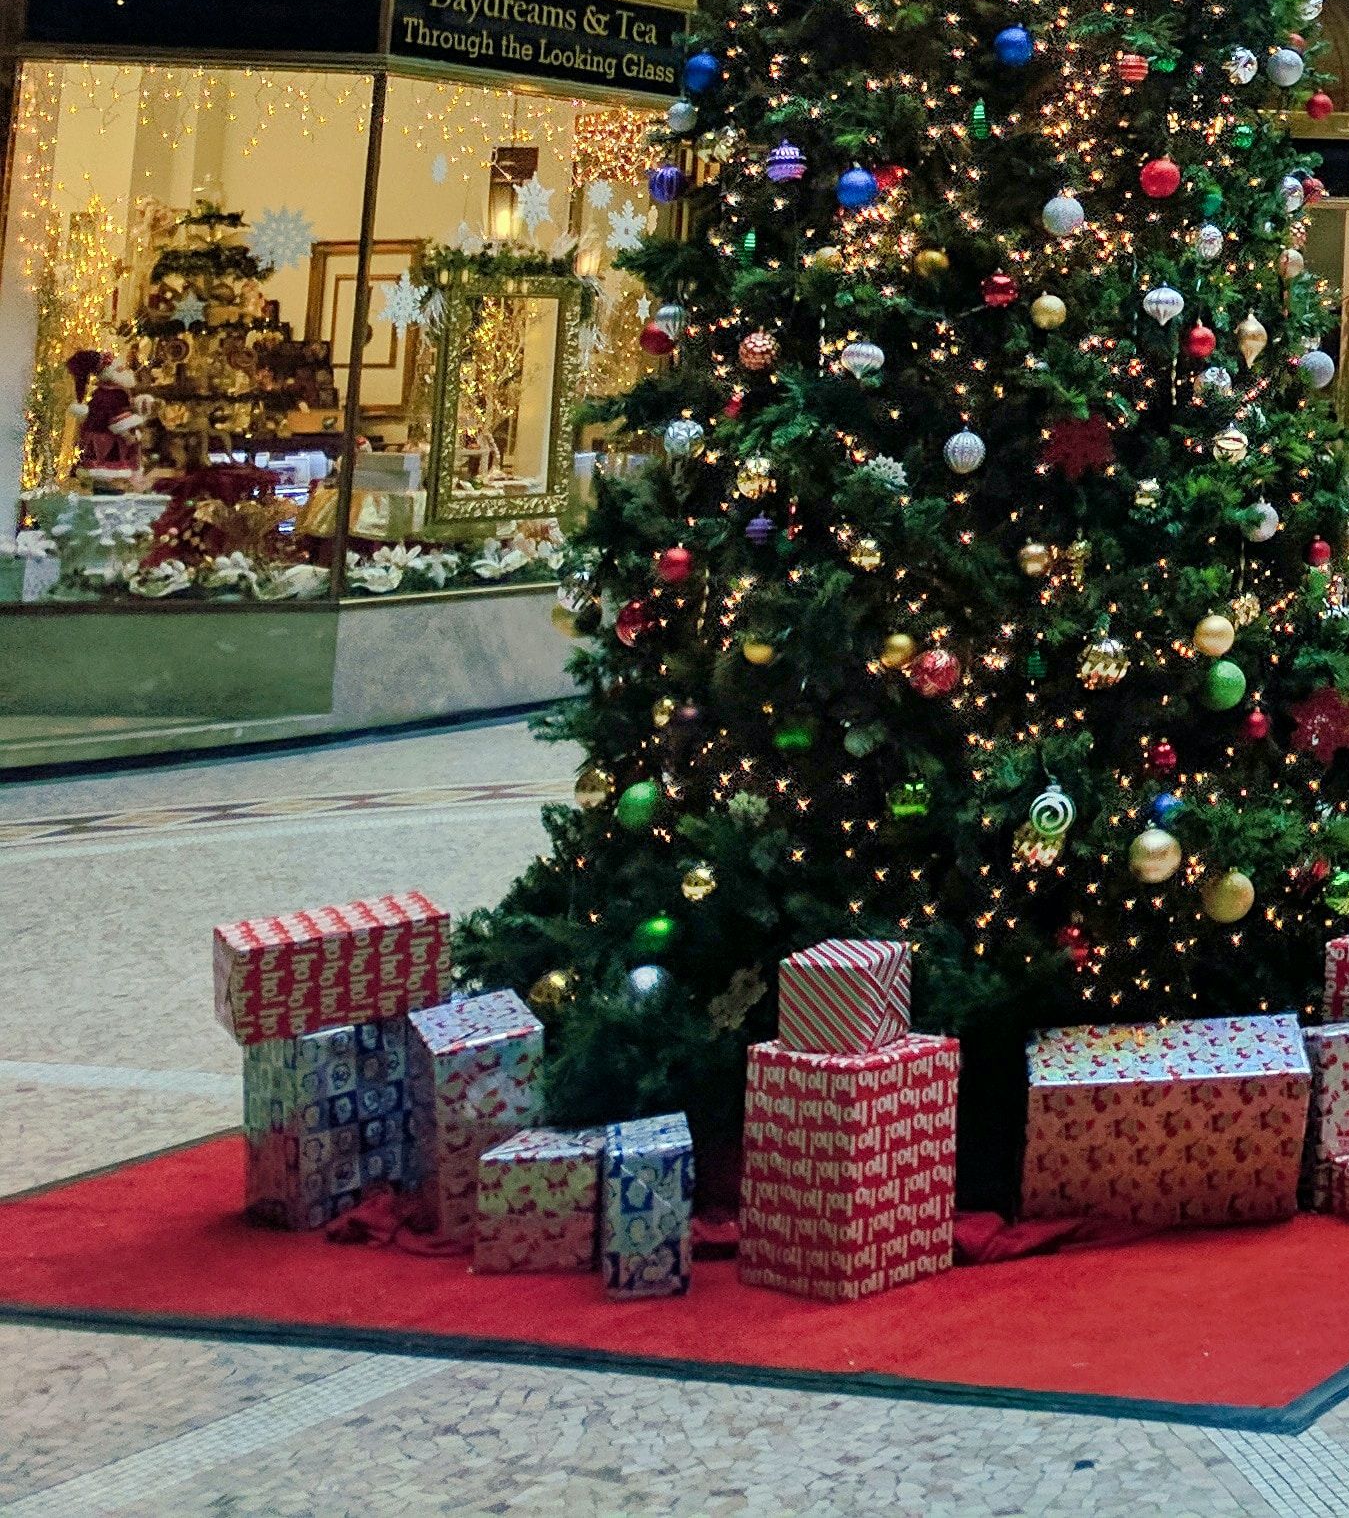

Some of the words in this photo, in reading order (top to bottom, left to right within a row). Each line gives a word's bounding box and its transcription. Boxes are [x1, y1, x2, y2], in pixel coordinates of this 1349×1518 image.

[403, 17, 494, 58] Through
[501, 34, 533, 61] the
[539, 39, 617, 79] Looking
[622, 53, 675, 83] Glass
[583, 5, 610, 36] &
[616, 10, 658, 45] Tea
